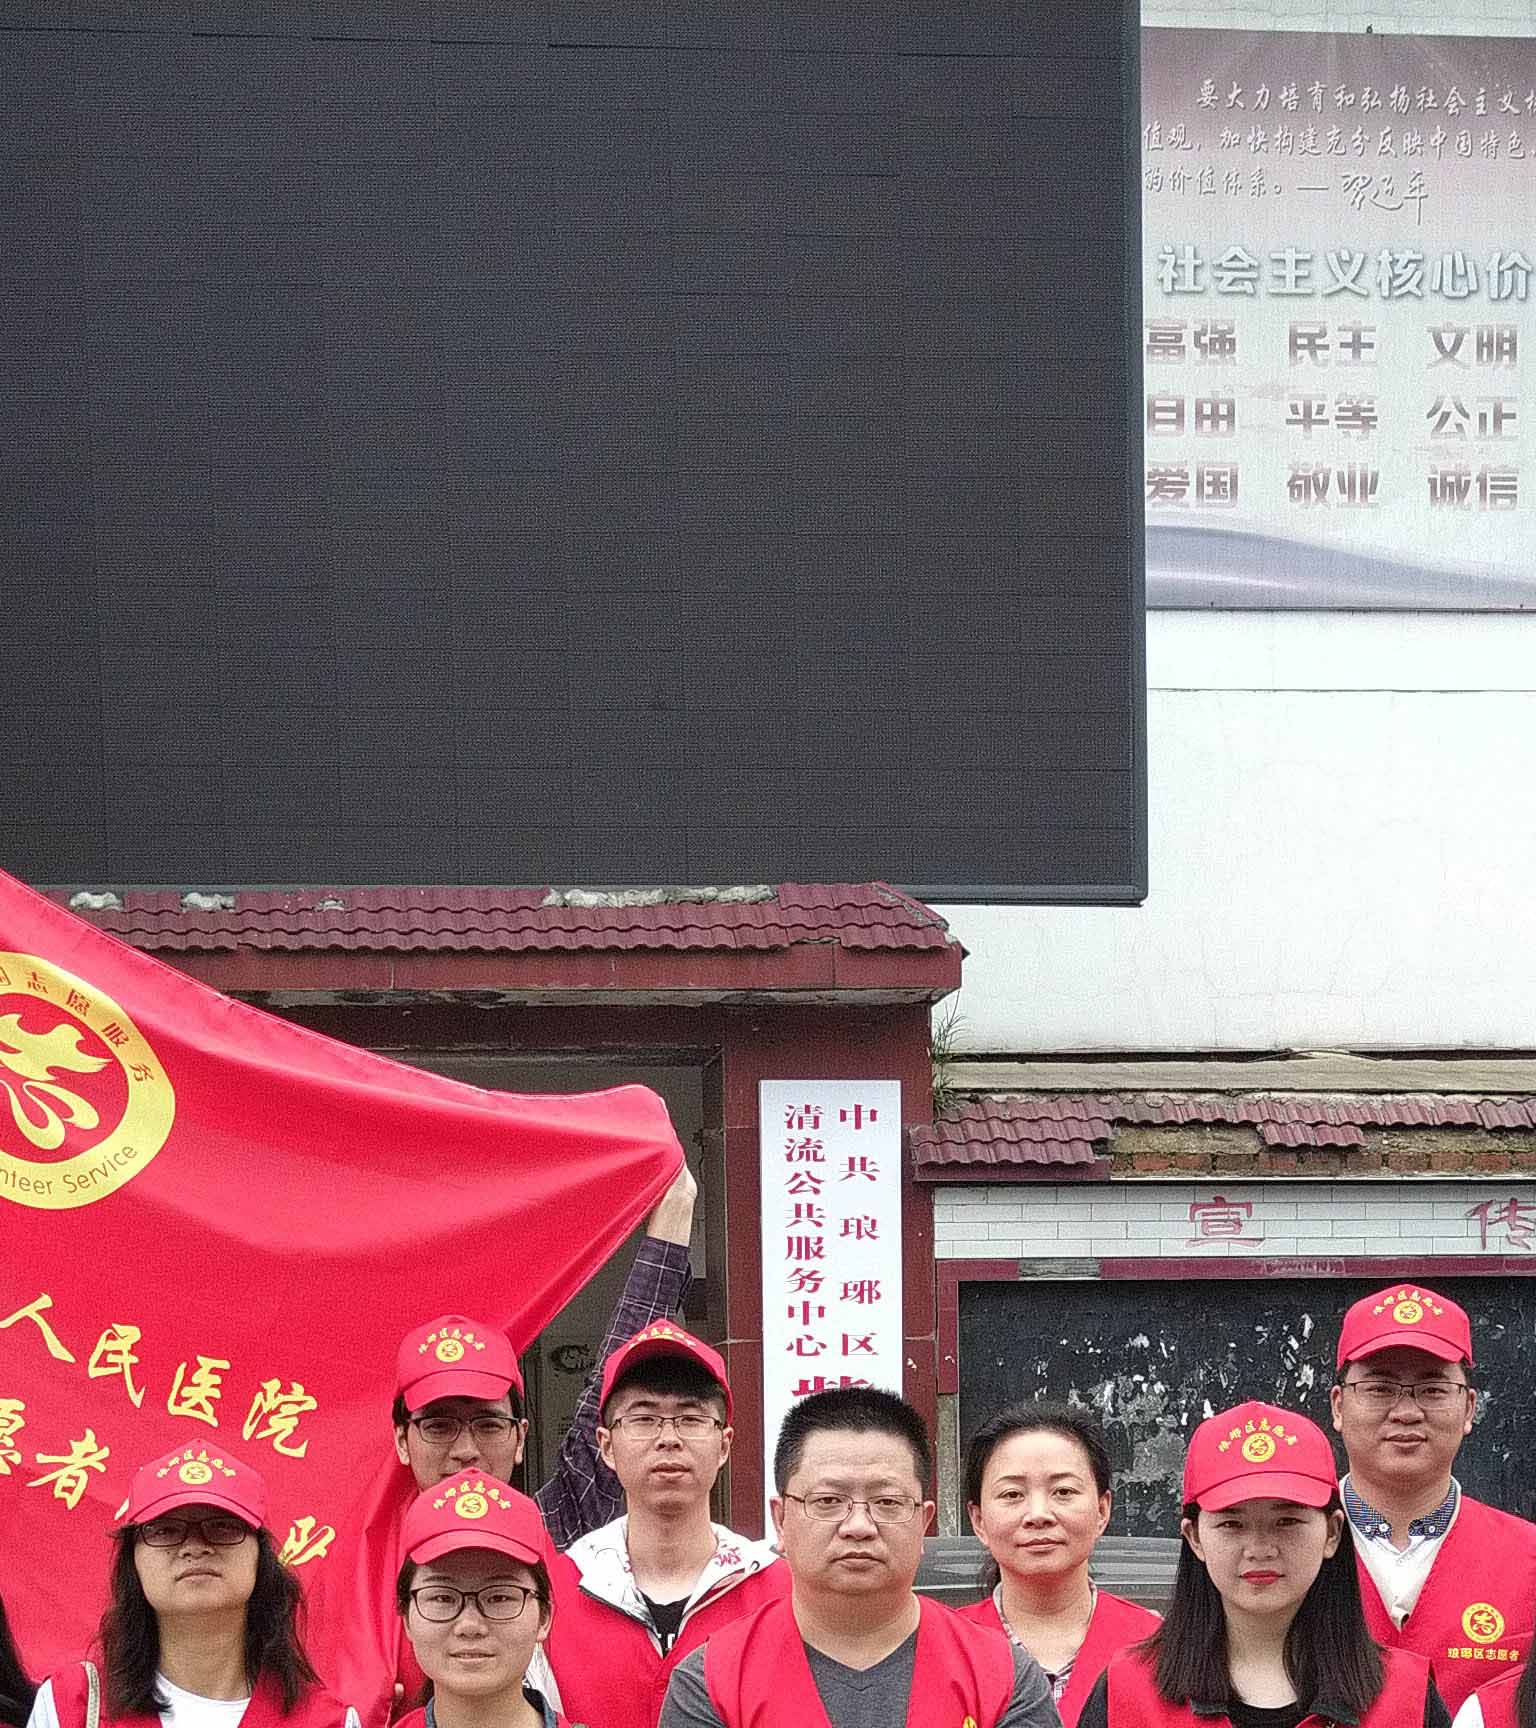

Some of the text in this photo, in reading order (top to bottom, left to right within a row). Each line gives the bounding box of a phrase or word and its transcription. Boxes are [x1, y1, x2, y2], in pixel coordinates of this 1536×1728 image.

[1146, 318, 1239, 371] 富强
[1286, 321, 1379, 371] 民主
[1426, 321, 1520, 373] 文明
[1146, 389, 1237, 439] 自由
[1284, 392, 1379, 441] 平等
[1425, 393, 1520, 443] 公正
[1146, 464, 1240, 513] 爱国
[1286, 463, 1380, 514] 敬业
[1426, 465, 1520, 513] 诚信
[62, 1143, 139, 1194] Service
[784, 1103, 828, 1357] 清流公共服务中心
[839, 1103, 882, 1357] 中共琅琊区
